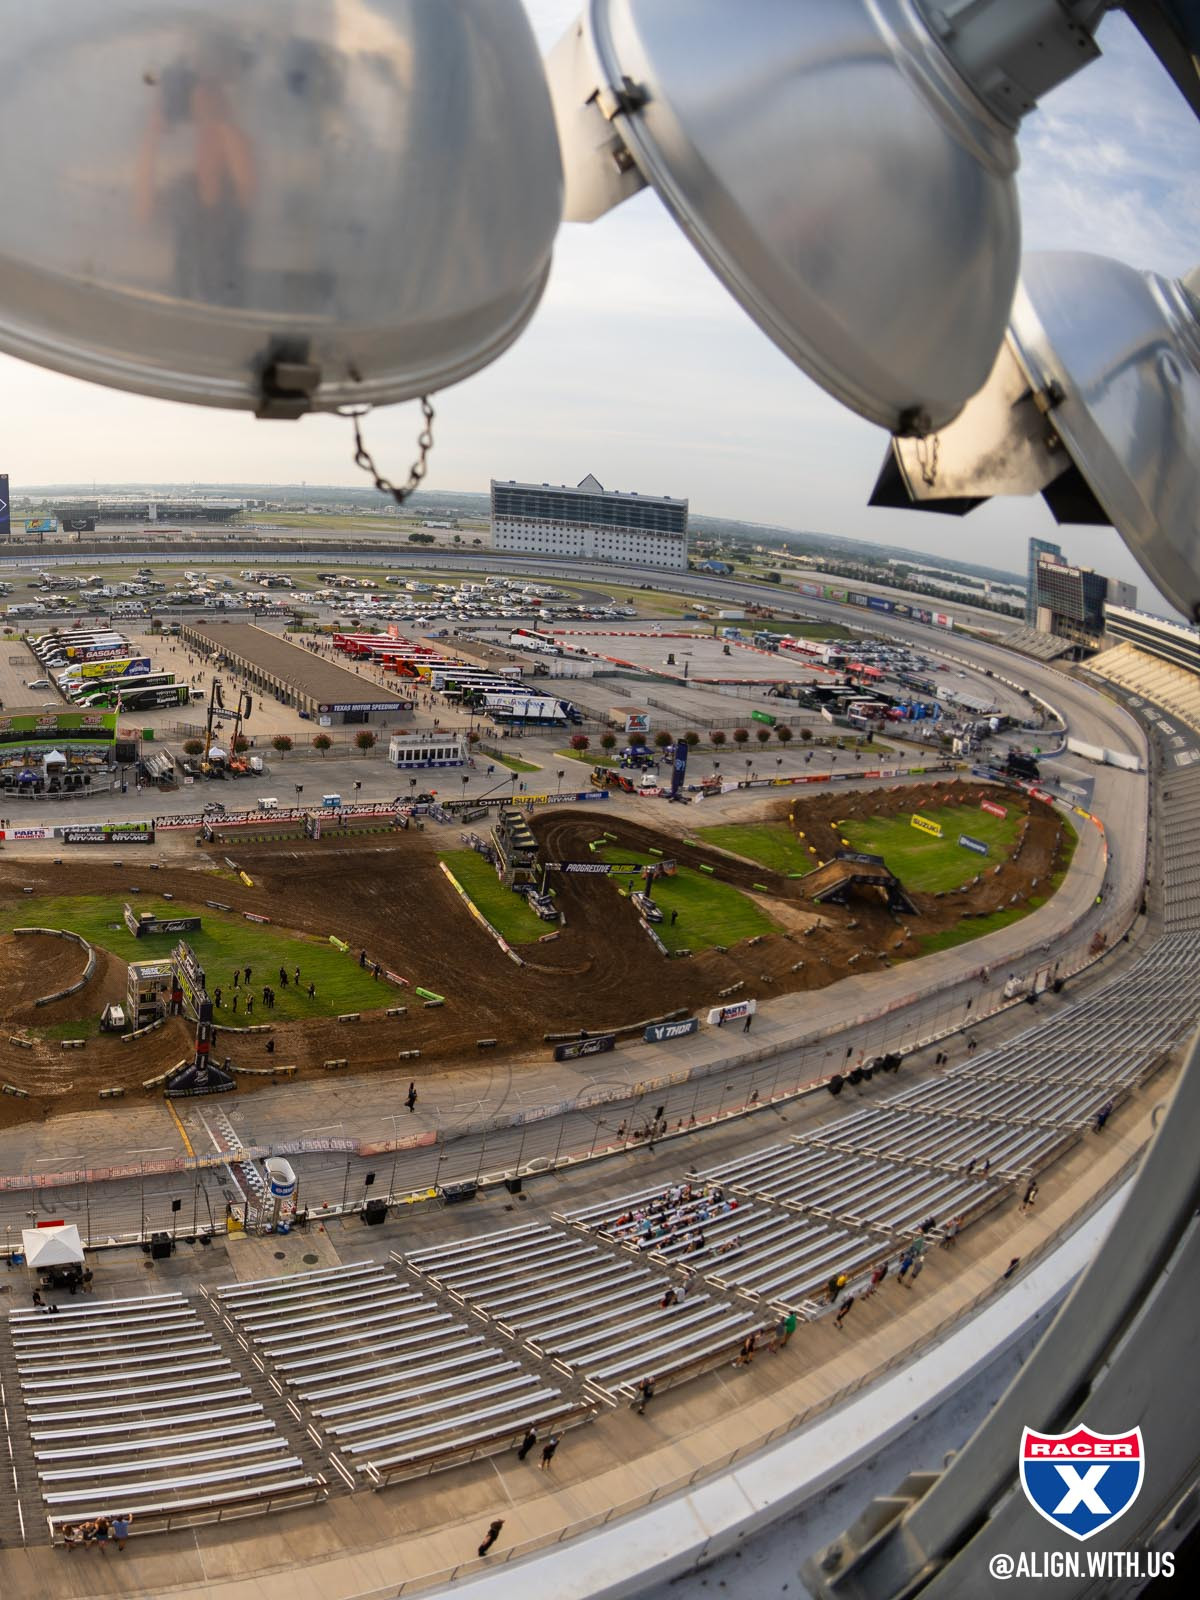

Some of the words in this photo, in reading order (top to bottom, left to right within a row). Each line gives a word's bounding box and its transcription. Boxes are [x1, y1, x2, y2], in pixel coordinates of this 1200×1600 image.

[86, 649, 121, 658] GASGAS
[514, 796, 546, 805] SUZUKI
[913, 818, 939, 832] SUZUKI
[566, 863, 611, 873] PROGRESSIVE
[666, 1023, 692, 1037] THOR
[578, 1040, 601, 1055] Finals
